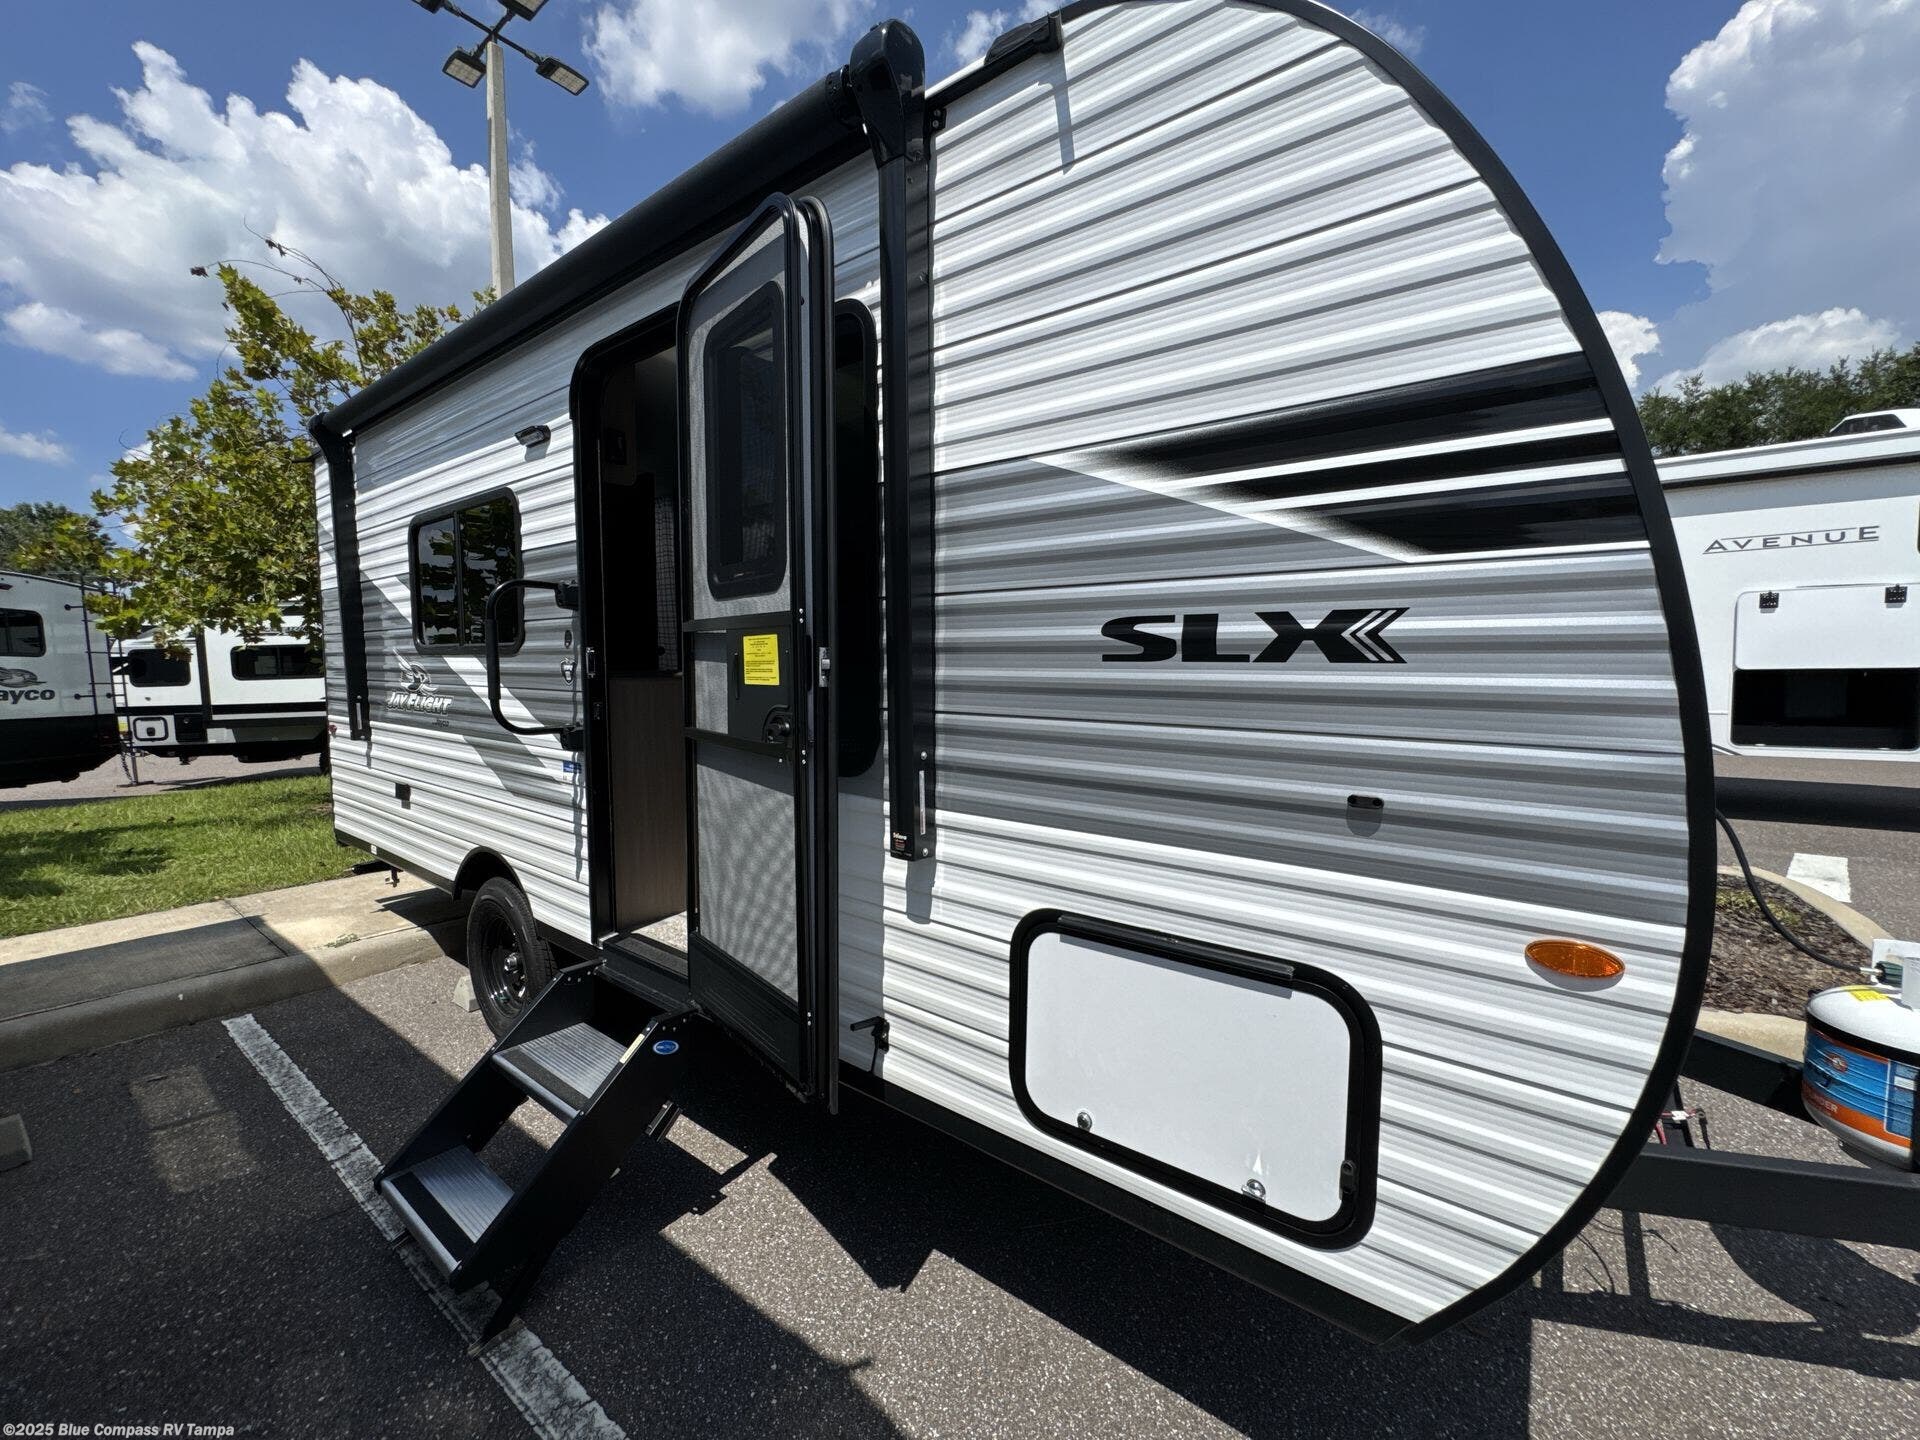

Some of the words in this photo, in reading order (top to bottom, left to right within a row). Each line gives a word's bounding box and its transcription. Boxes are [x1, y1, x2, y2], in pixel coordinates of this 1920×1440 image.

[1703, 525, 1880, 554] AVENUE
[1101, 607, 1410, 664] SLX
[0, 689, 55, 705] ayco
[386, 691, 408, 709] JAY
[408, 693, 453, 714] FLIGHT
